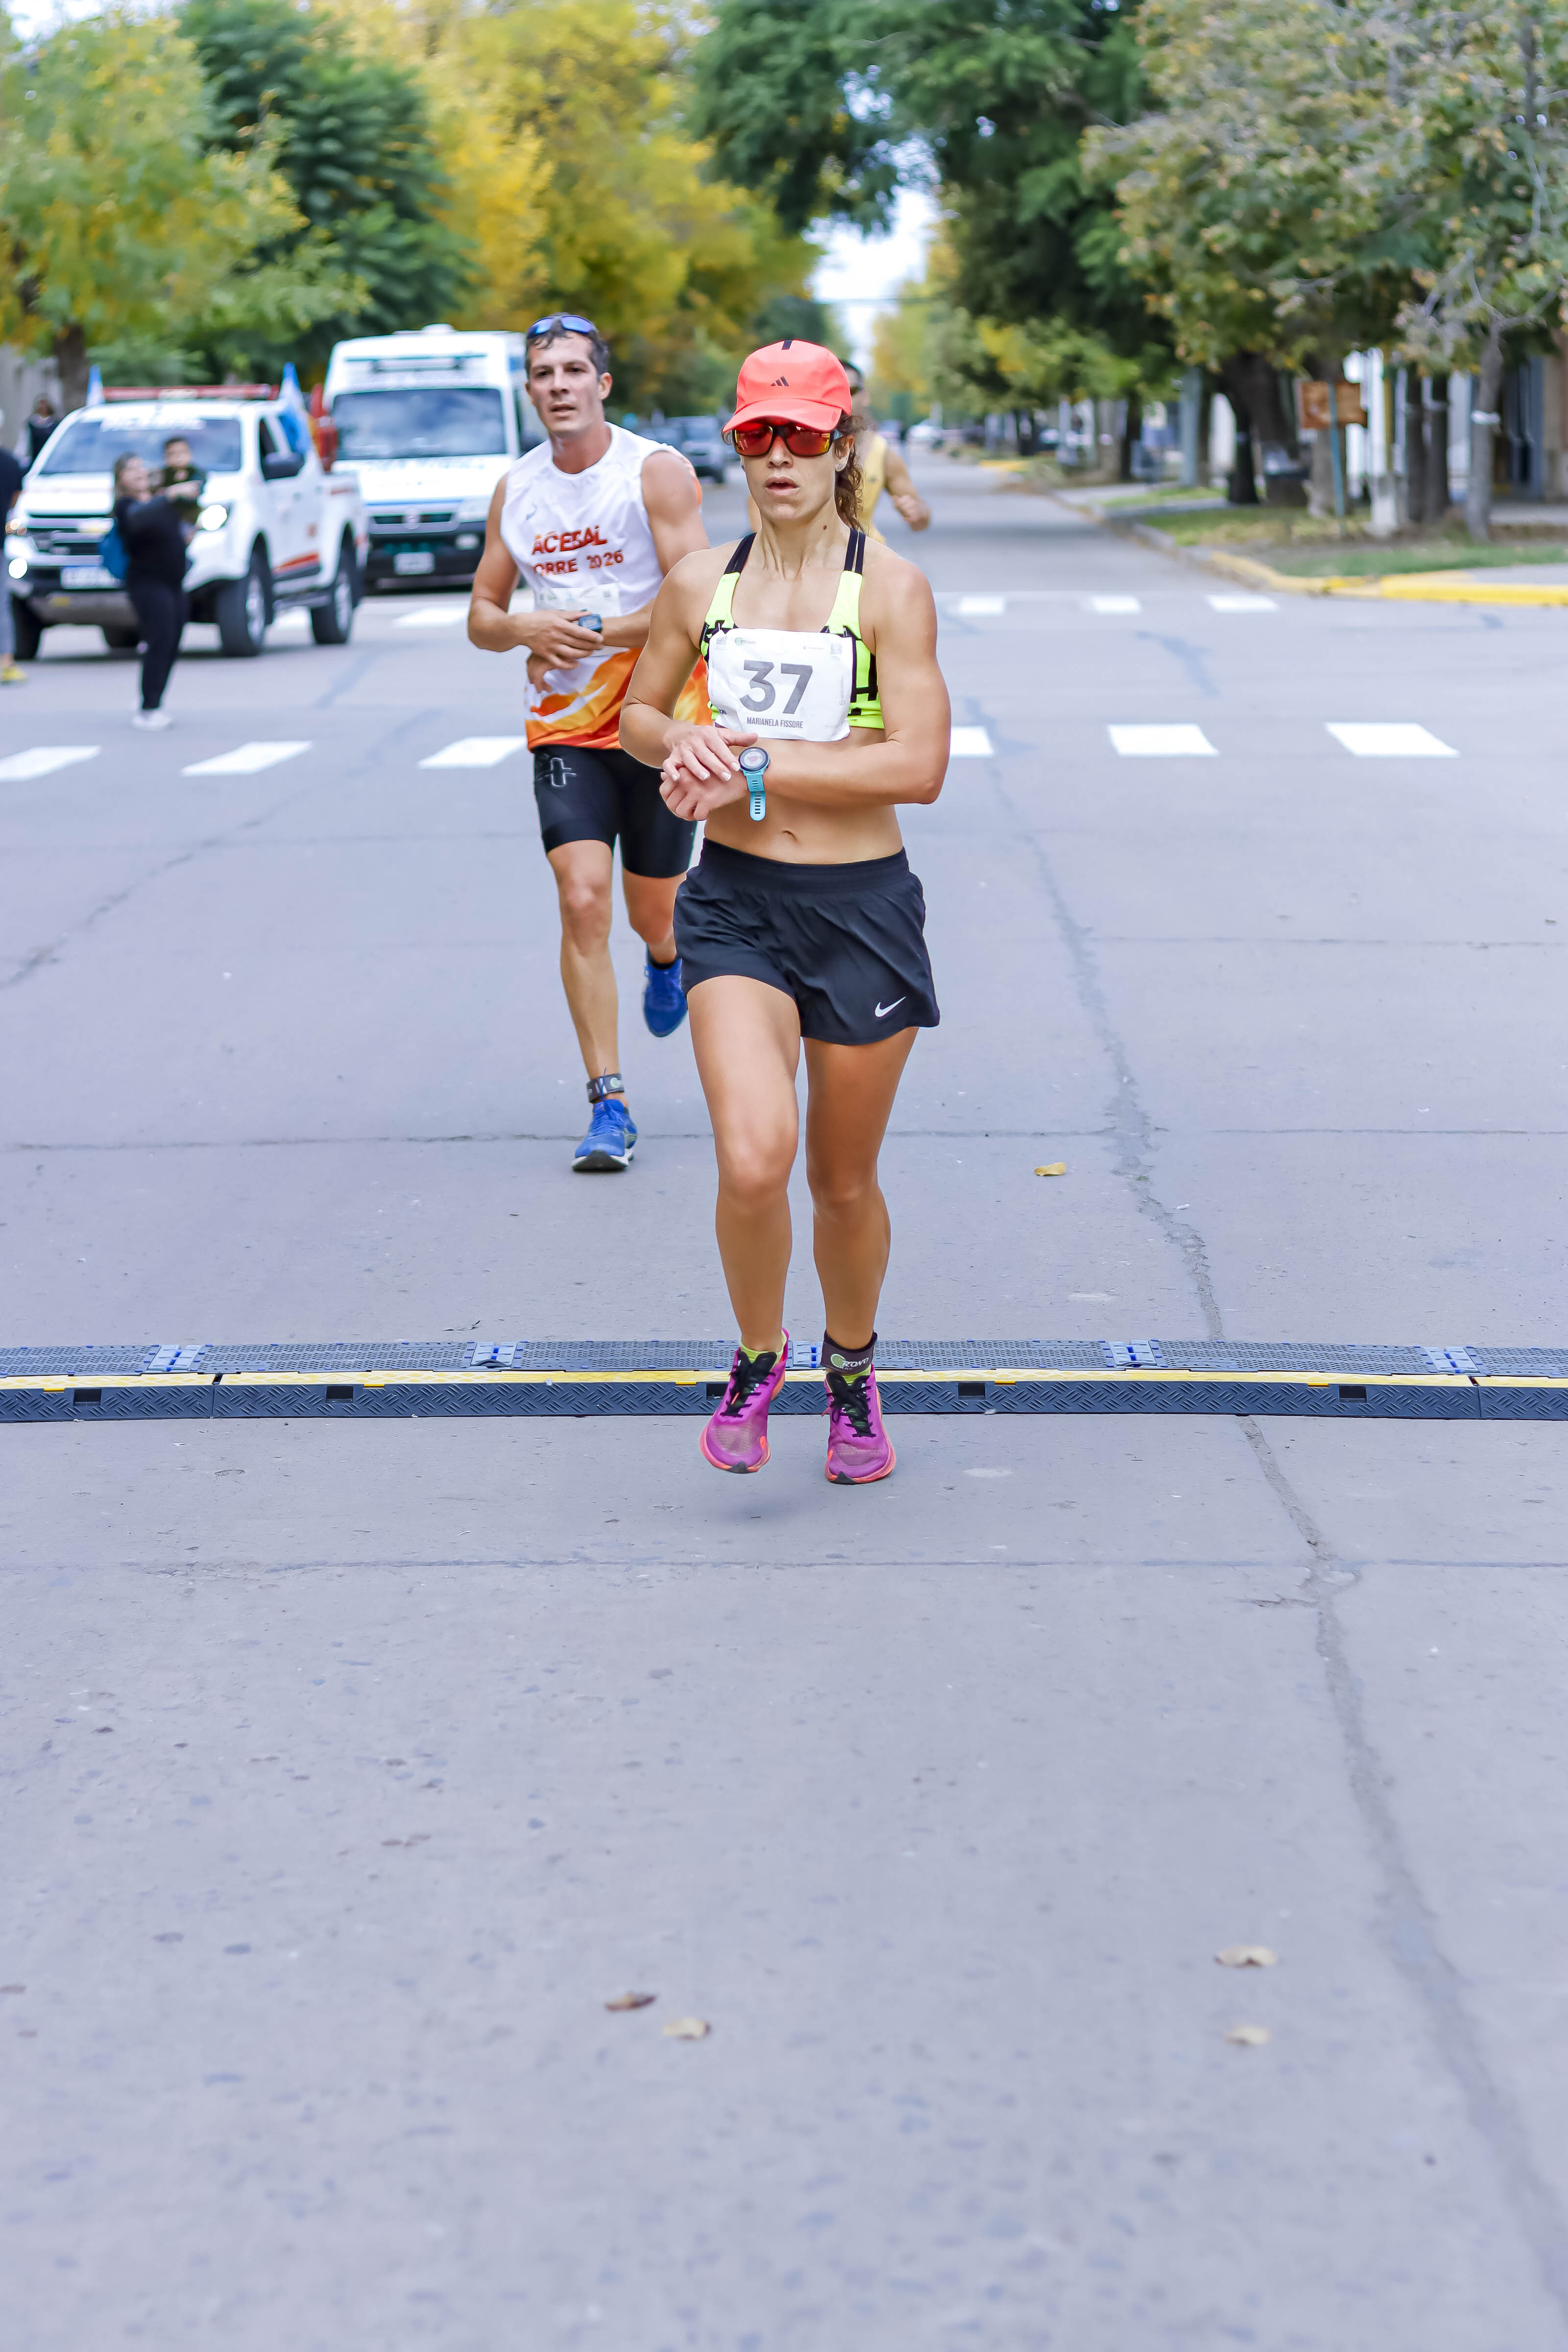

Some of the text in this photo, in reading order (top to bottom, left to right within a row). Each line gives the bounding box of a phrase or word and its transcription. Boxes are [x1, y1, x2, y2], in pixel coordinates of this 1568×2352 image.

[587, 550, 624, 568] 2026
[739, 660, 813, 714] 37
[746, 717, 779, 727] MARIANELA
[780, 719, 804, 729] FISSORE
